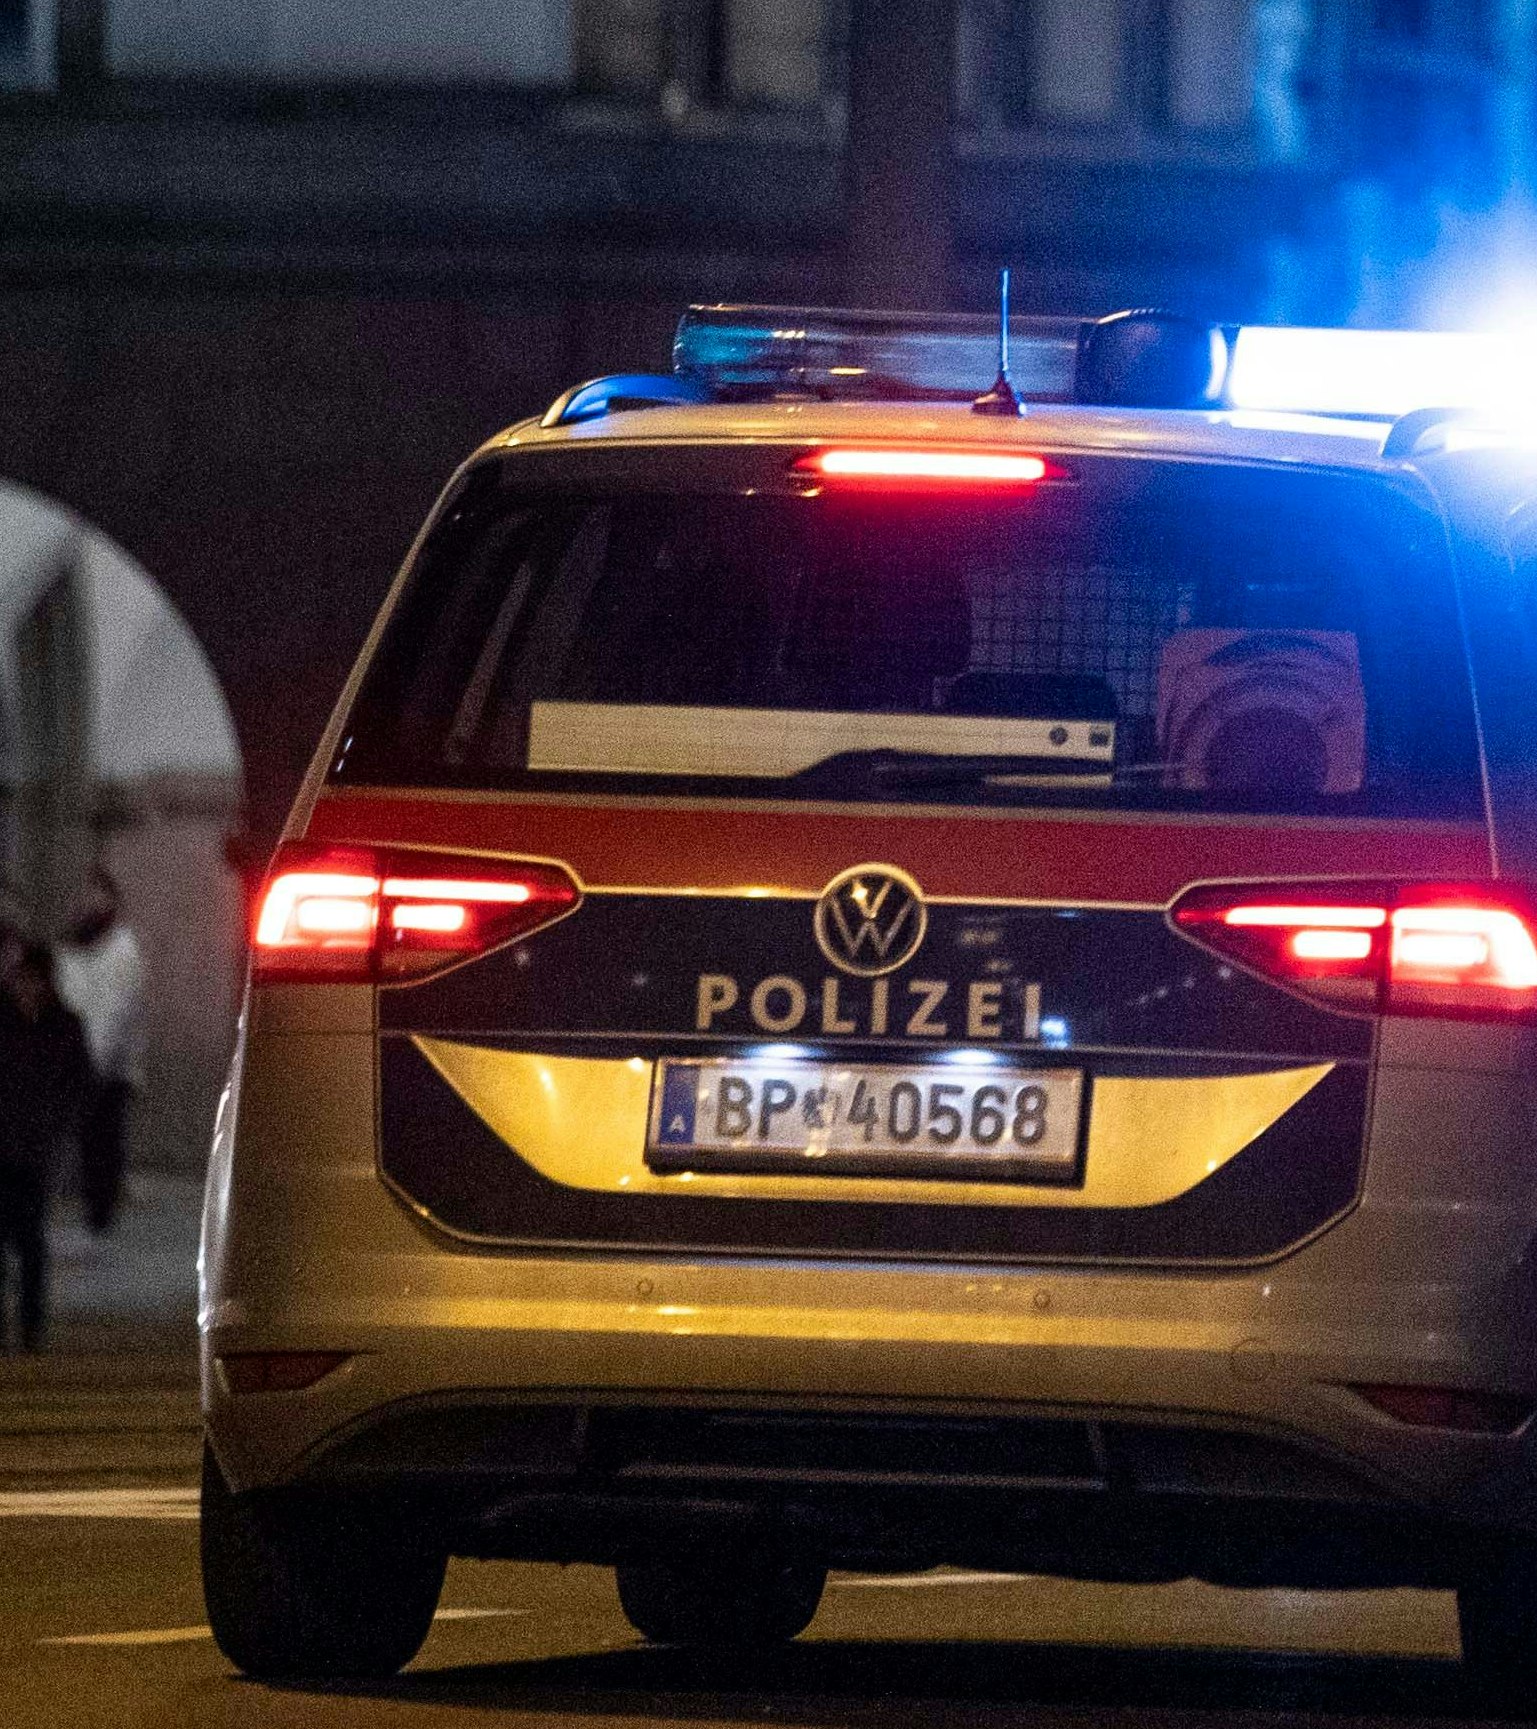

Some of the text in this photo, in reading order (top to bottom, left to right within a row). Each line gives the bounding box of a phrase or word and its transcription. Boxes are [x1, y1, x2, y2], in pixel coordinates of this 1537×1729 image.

[820, 868, 922, 970] VW
[696, 973, 1041, 1038] POLIZEI
[669, 1114, 686, 1132] A
[717, 1076, 1047, 1146] BP 40568
